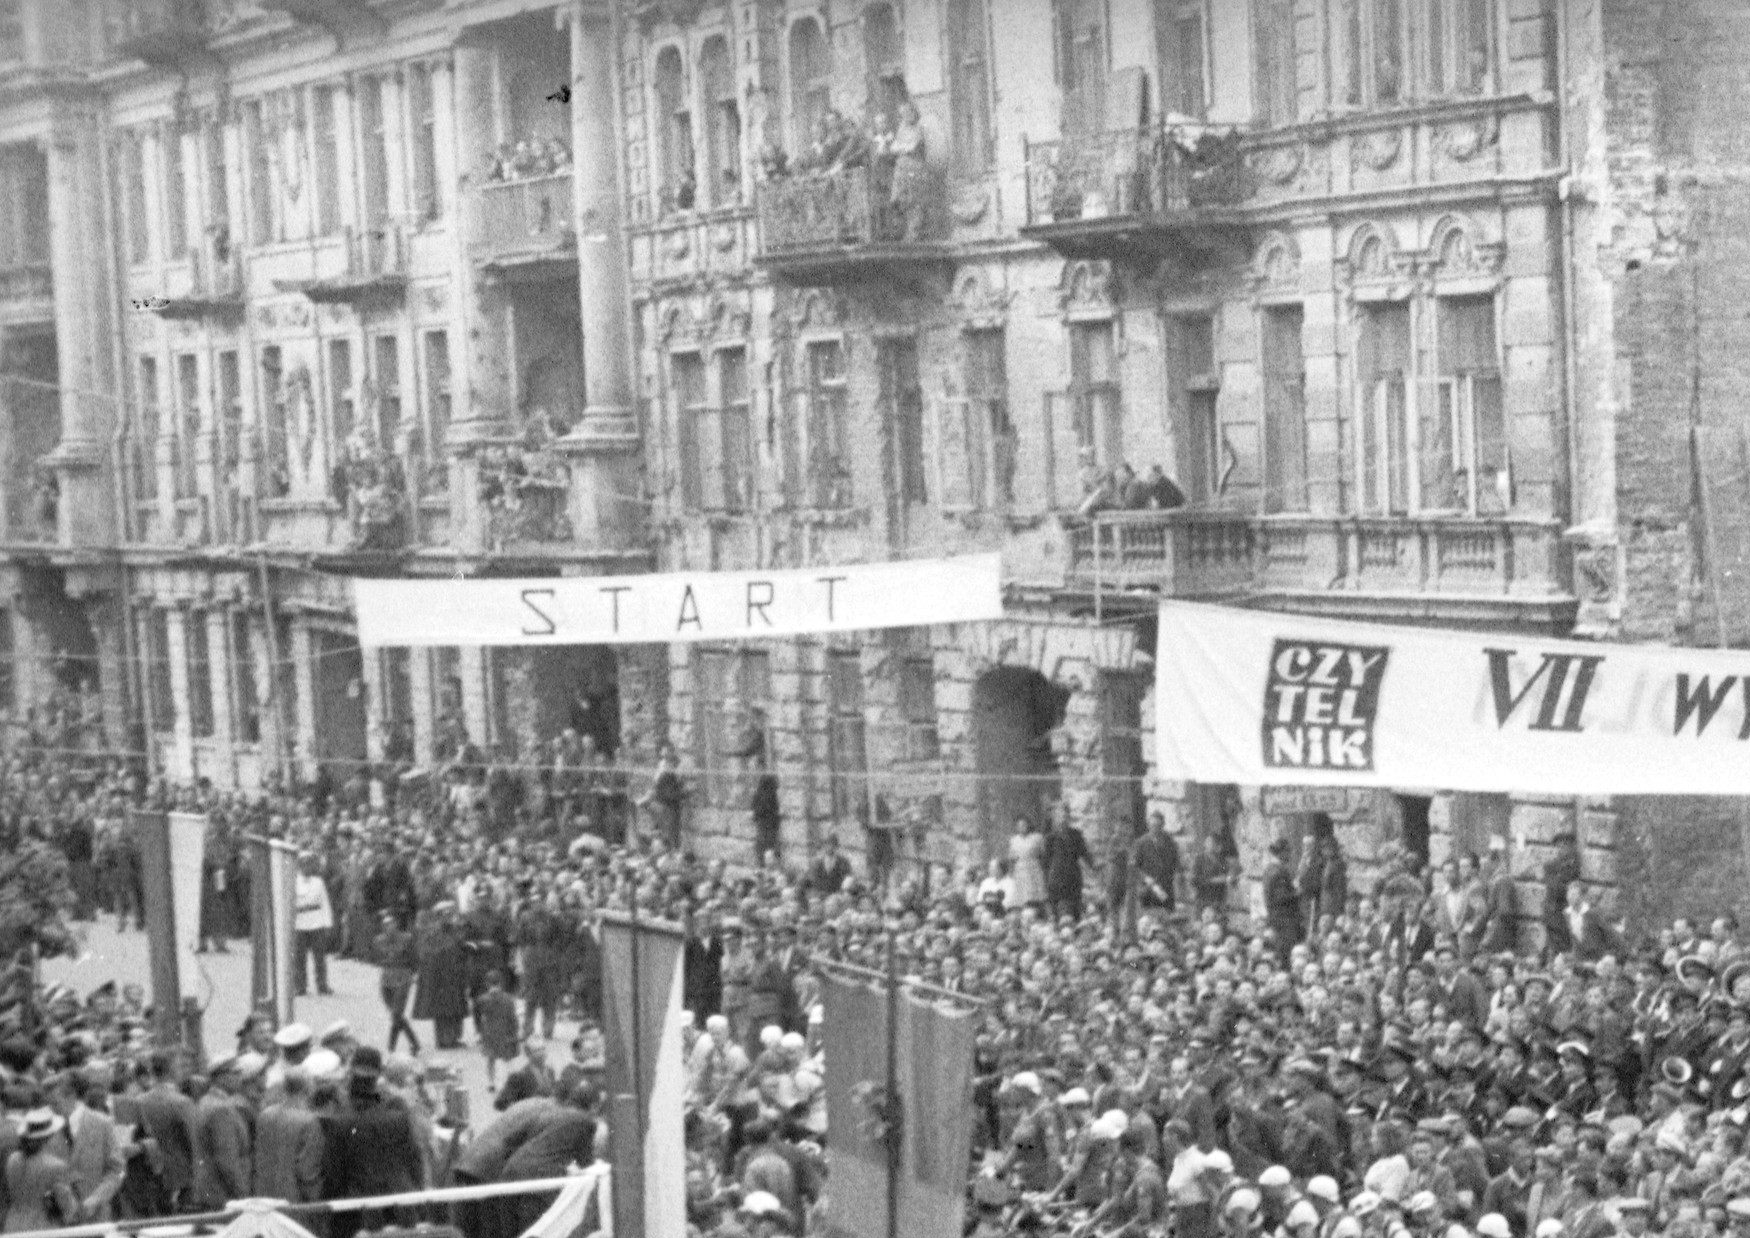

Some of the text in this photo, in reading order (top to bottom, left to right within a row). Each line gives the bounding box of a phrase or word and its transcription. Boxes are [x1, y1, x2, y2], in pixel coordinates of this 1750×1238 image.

[520, 576, 849, 636] START
[1276, 646, 1382, 686] CZY
[1483, 647, 1605, 732] VII
[1272, 684, 1366, 725] TEL
